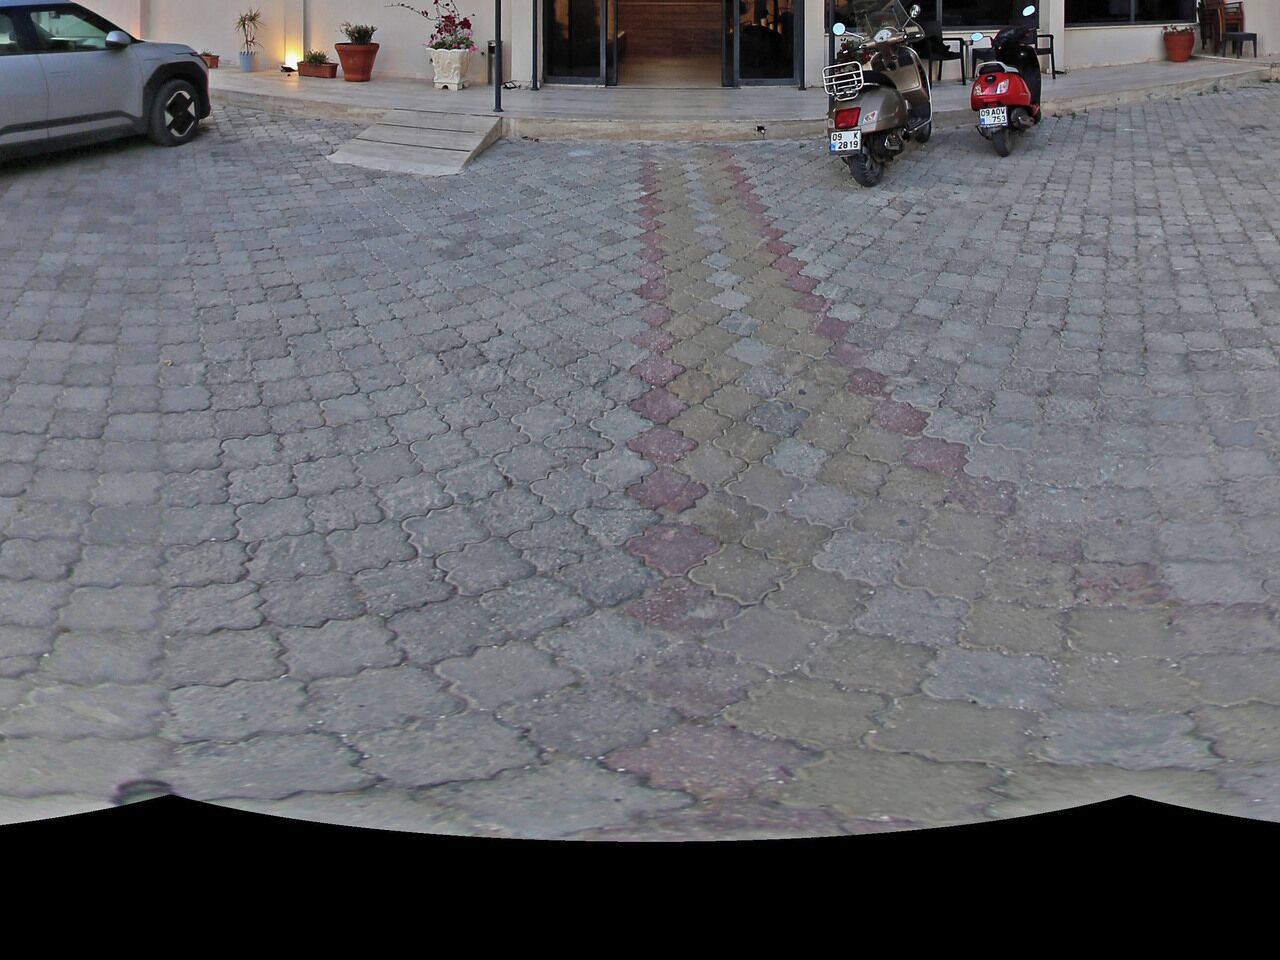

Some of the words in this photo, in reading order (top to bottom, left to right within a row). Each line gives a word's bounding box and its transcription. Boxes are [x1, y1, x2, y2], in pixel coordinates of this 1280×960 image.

[832, 133, 842, 141] 09
[853, 131, 859, 139] K
[838, 140, 858, 149] 2819
